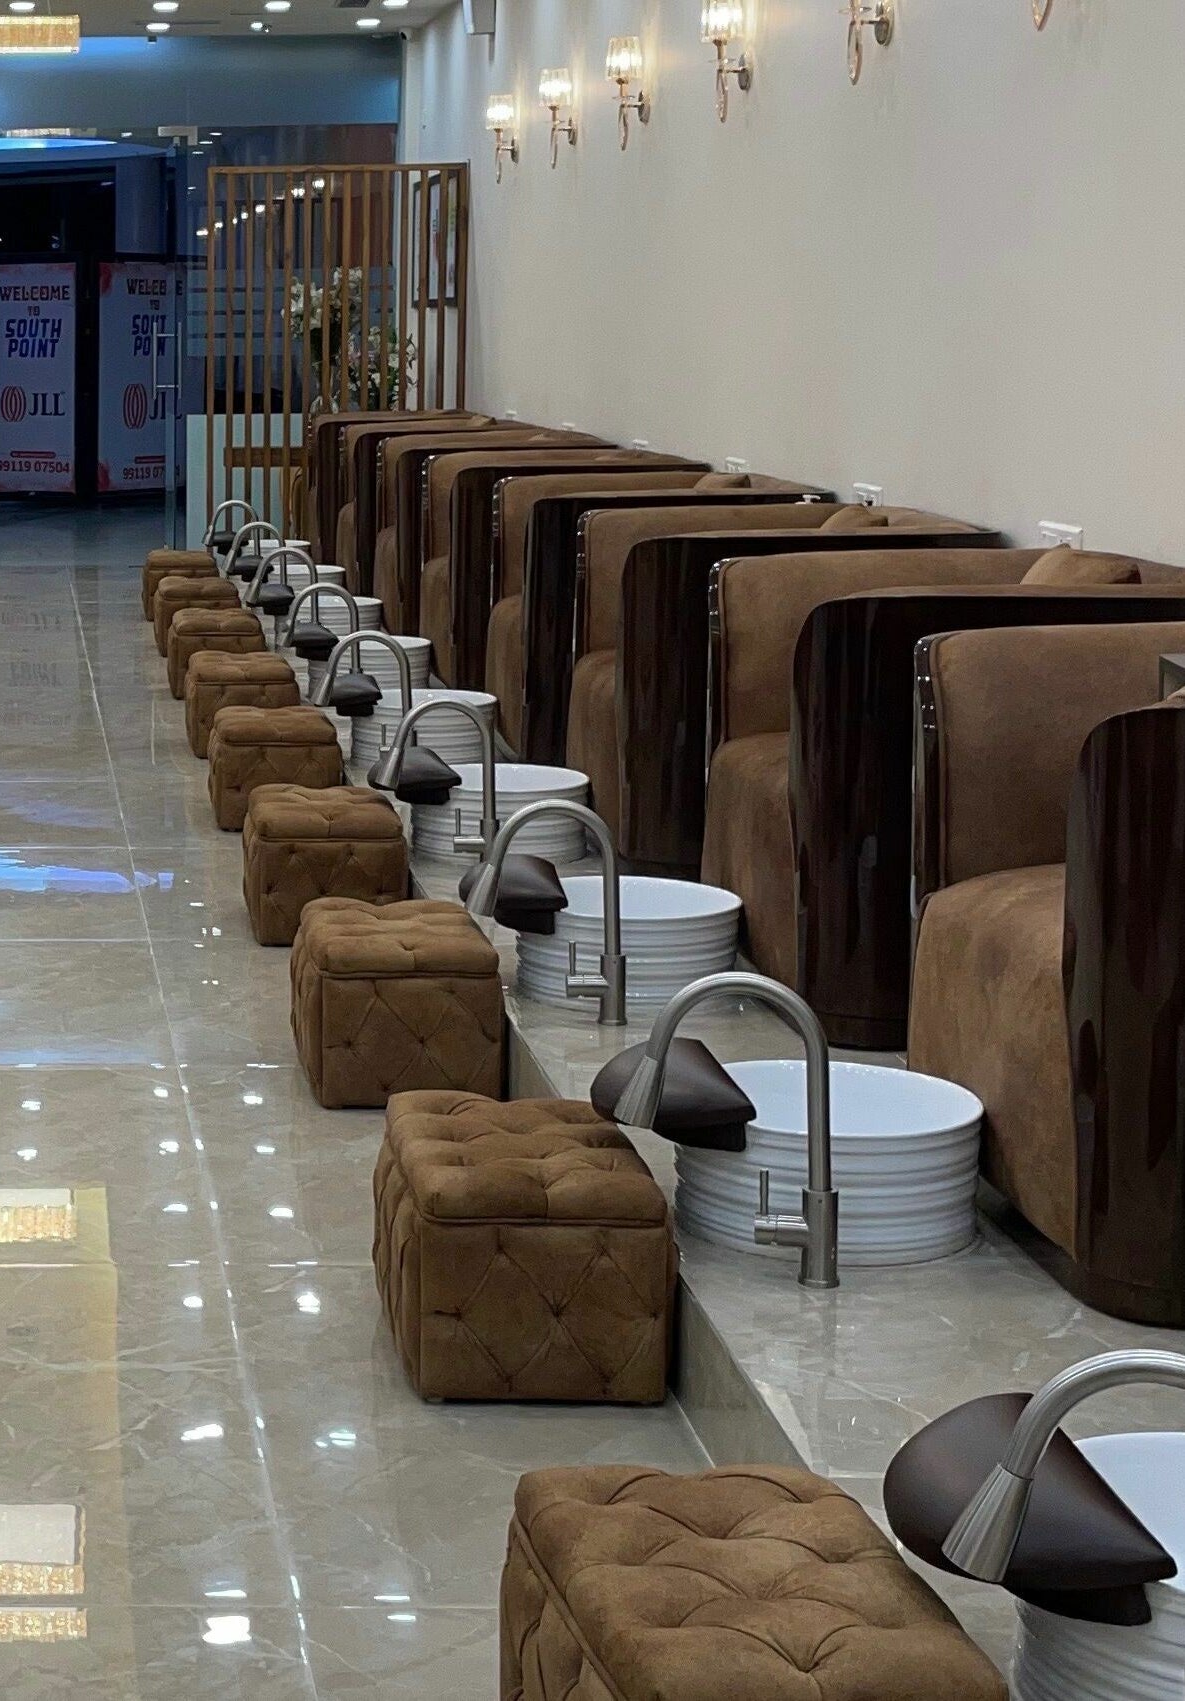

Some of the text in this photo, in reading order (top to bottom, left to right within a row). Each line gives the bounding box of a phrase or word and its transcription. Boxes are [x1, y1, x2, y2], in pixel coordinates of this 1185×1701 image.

[0, 285, 71, 301] WELCOME
[27, 305, 41, 316] TO
[4, 318, 63, 338] SOUTH
[7, 338, 60, 358] POINT
[28, 392, 66, 416] JLL
[33, 461, 70, 473] 07504
